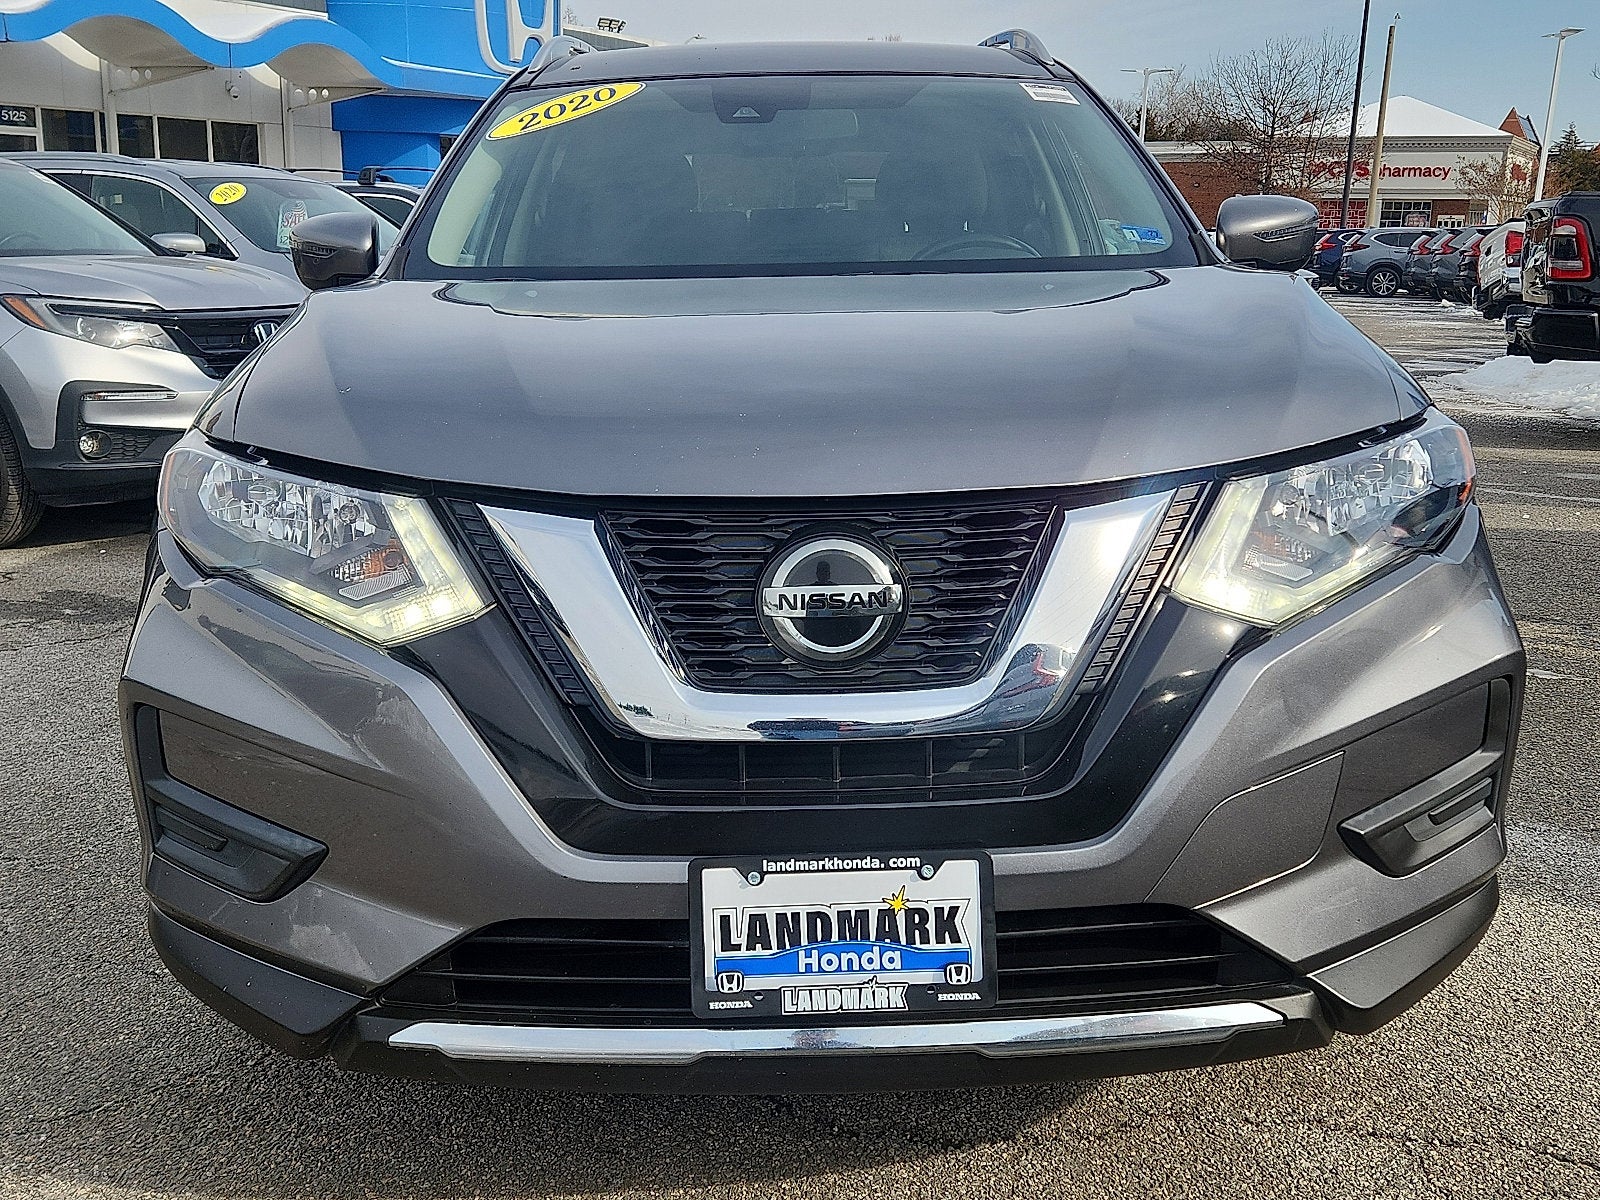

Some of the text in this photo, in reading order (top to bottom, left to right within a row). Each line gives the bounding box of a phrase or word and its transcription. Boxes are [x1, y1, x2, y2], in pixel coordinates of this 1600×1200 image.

[1, 110, 27, 121] 5125
[518, 87, 617, 131] 2020
[215, 183, 241, 202] 2020
[778, 591, 888, 611] NISSAN
[762, 856, 921, 872] landmarkhonda. com
[717, 905, 964, 952] LANDMARK
[798, 946, 903, 973] Honda
[708, 1000, 754, 1010] HONDA
[783, 985, 907, 1012] LANDMARK
[937, 992, 982, 1002] HONDA
